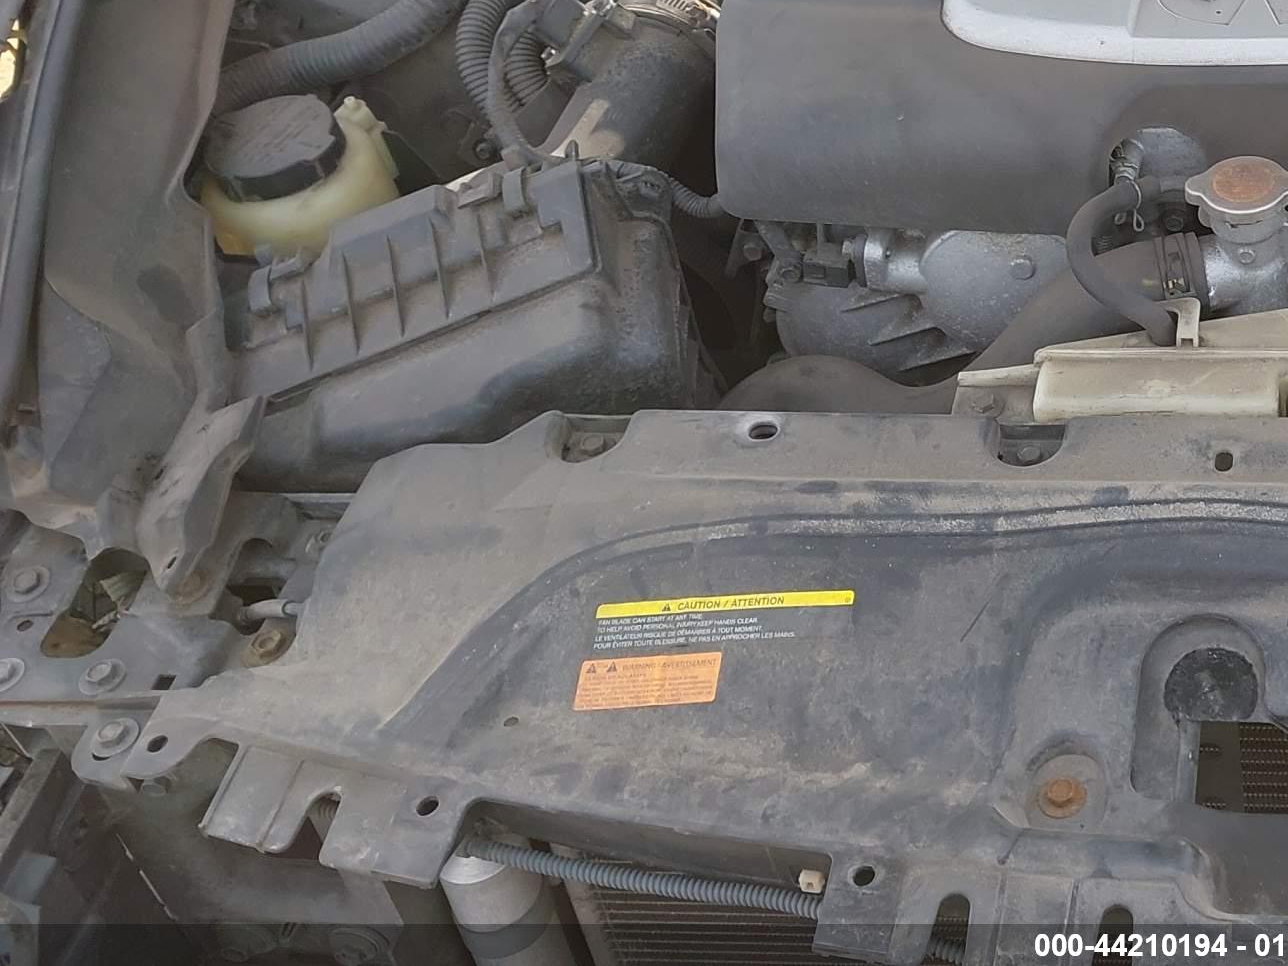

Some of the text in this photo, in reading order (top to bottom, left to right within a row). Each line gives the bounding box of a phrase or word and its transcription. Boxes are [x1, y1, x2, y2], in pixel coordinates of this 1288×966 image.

[677, 599, 721, 611] CAUTION
[731, 596, 785, 608] ATTENTION
[632, 616, 646, 624] CAN
[646, 615, 666, 623] START
[606, 625, 623, 633] HELP
[623, 624, 642, 632] AVOID
[718, 626, 734, 634] TOUT
[593, 642, 612, 650] POUR
[634, 639, 654, 647] TOUTE
